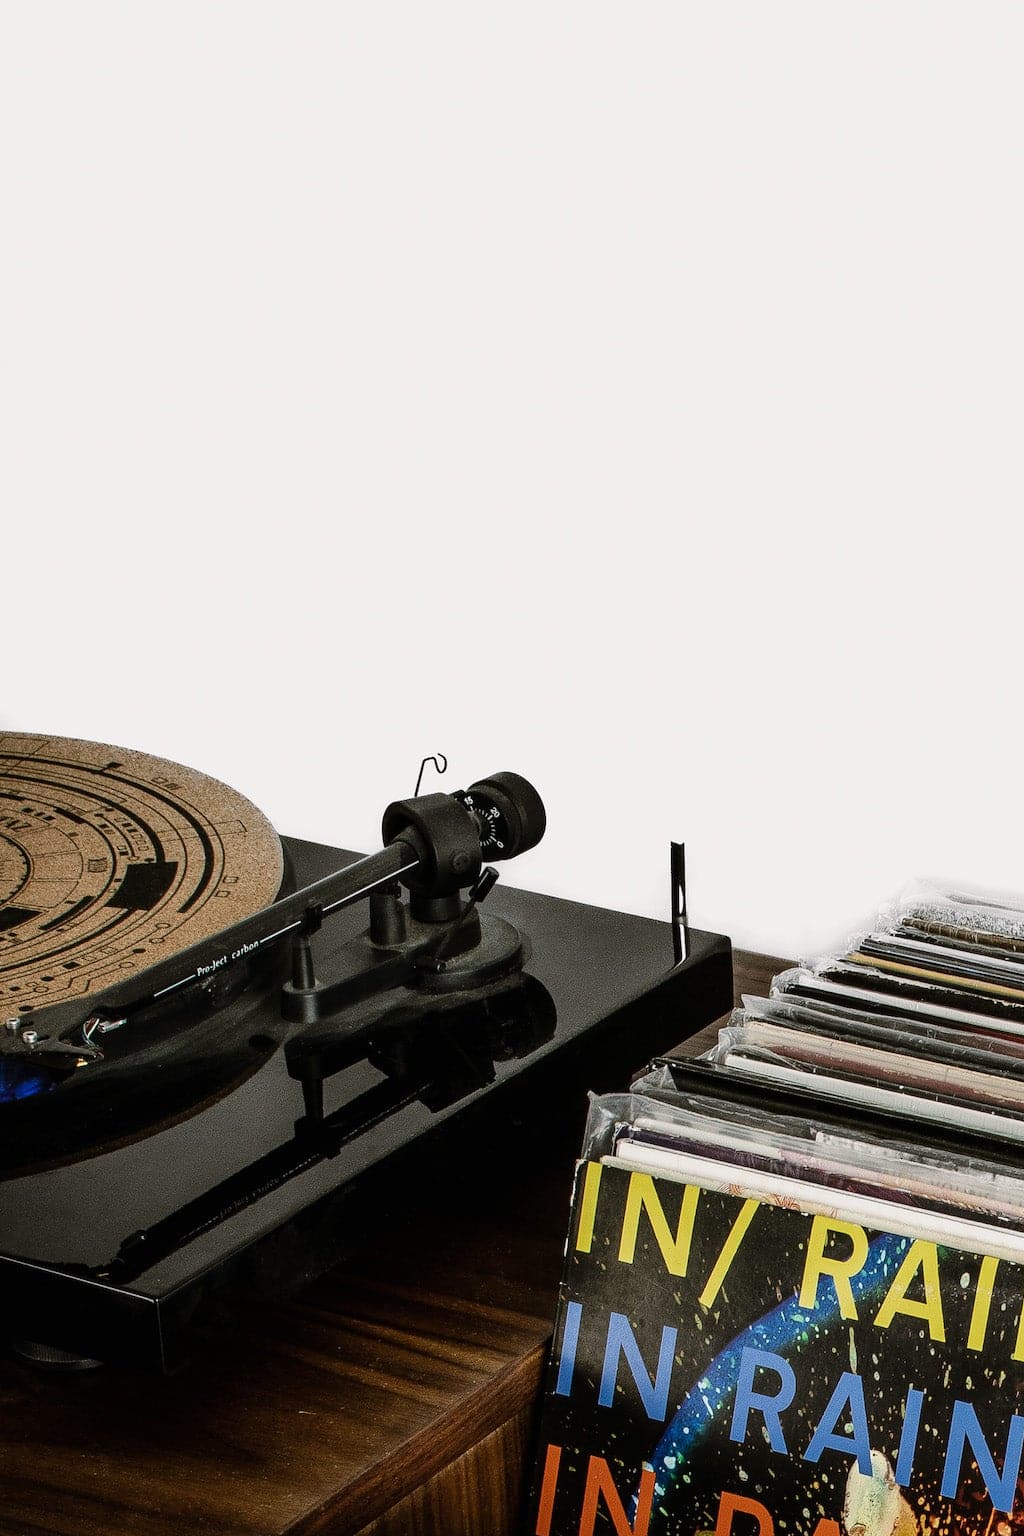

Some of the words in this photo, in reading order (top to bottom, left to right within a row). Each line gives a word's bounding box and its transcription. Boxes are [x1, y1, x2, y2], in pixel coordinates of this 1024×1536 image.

[464, 796, 474, 805] 15
[490, 807, 501, 818] 20
[497, 840, 505, 849] 0
[231, 940, 259, 959] carbon
[575, 1162, 762, 1309] IN/
[554, 1300, 678, 1423] IN
